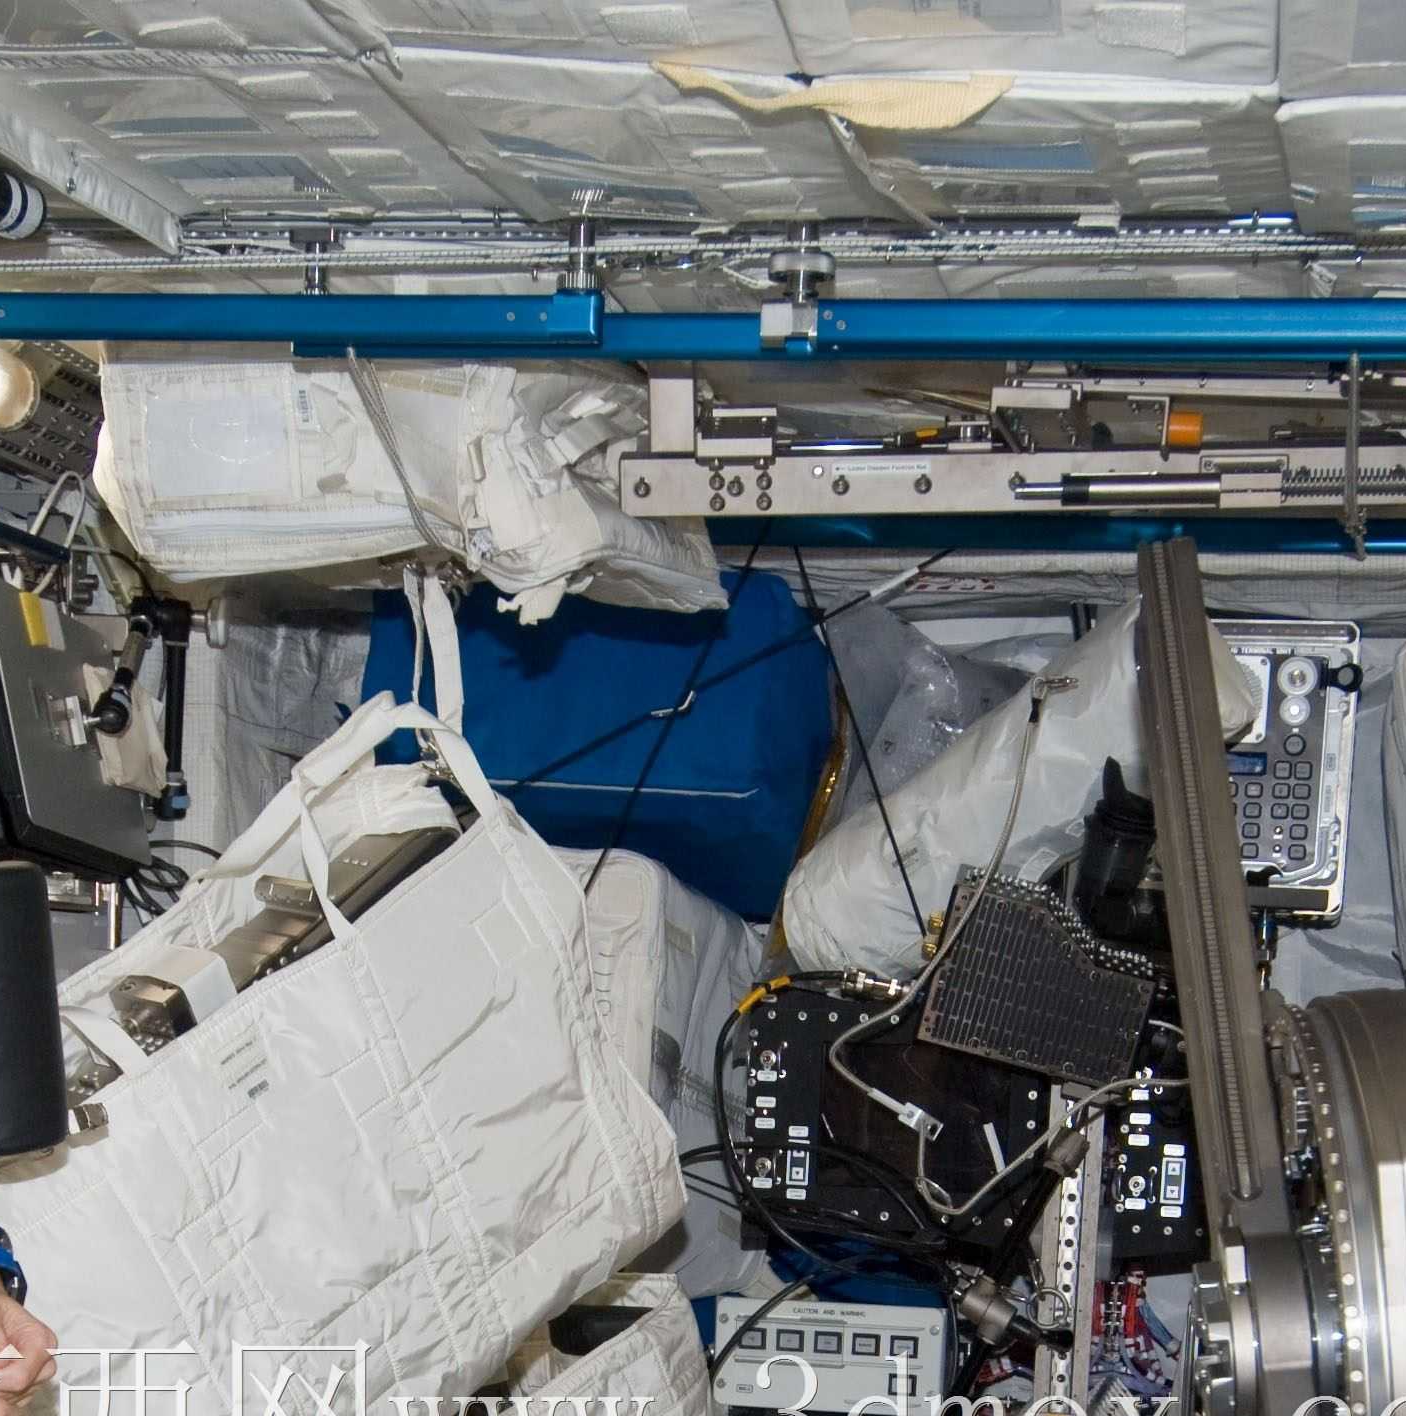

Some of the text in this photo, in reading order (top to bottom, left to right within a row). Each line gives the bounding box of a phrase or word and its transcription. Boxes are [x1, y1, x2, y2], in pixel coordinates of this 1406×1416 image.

[1241, 647, 1274, 655] TERMINAL
[793, 1307, 819, 1316] CAUTION
[840, 1310, 867, 1318] WARNING
